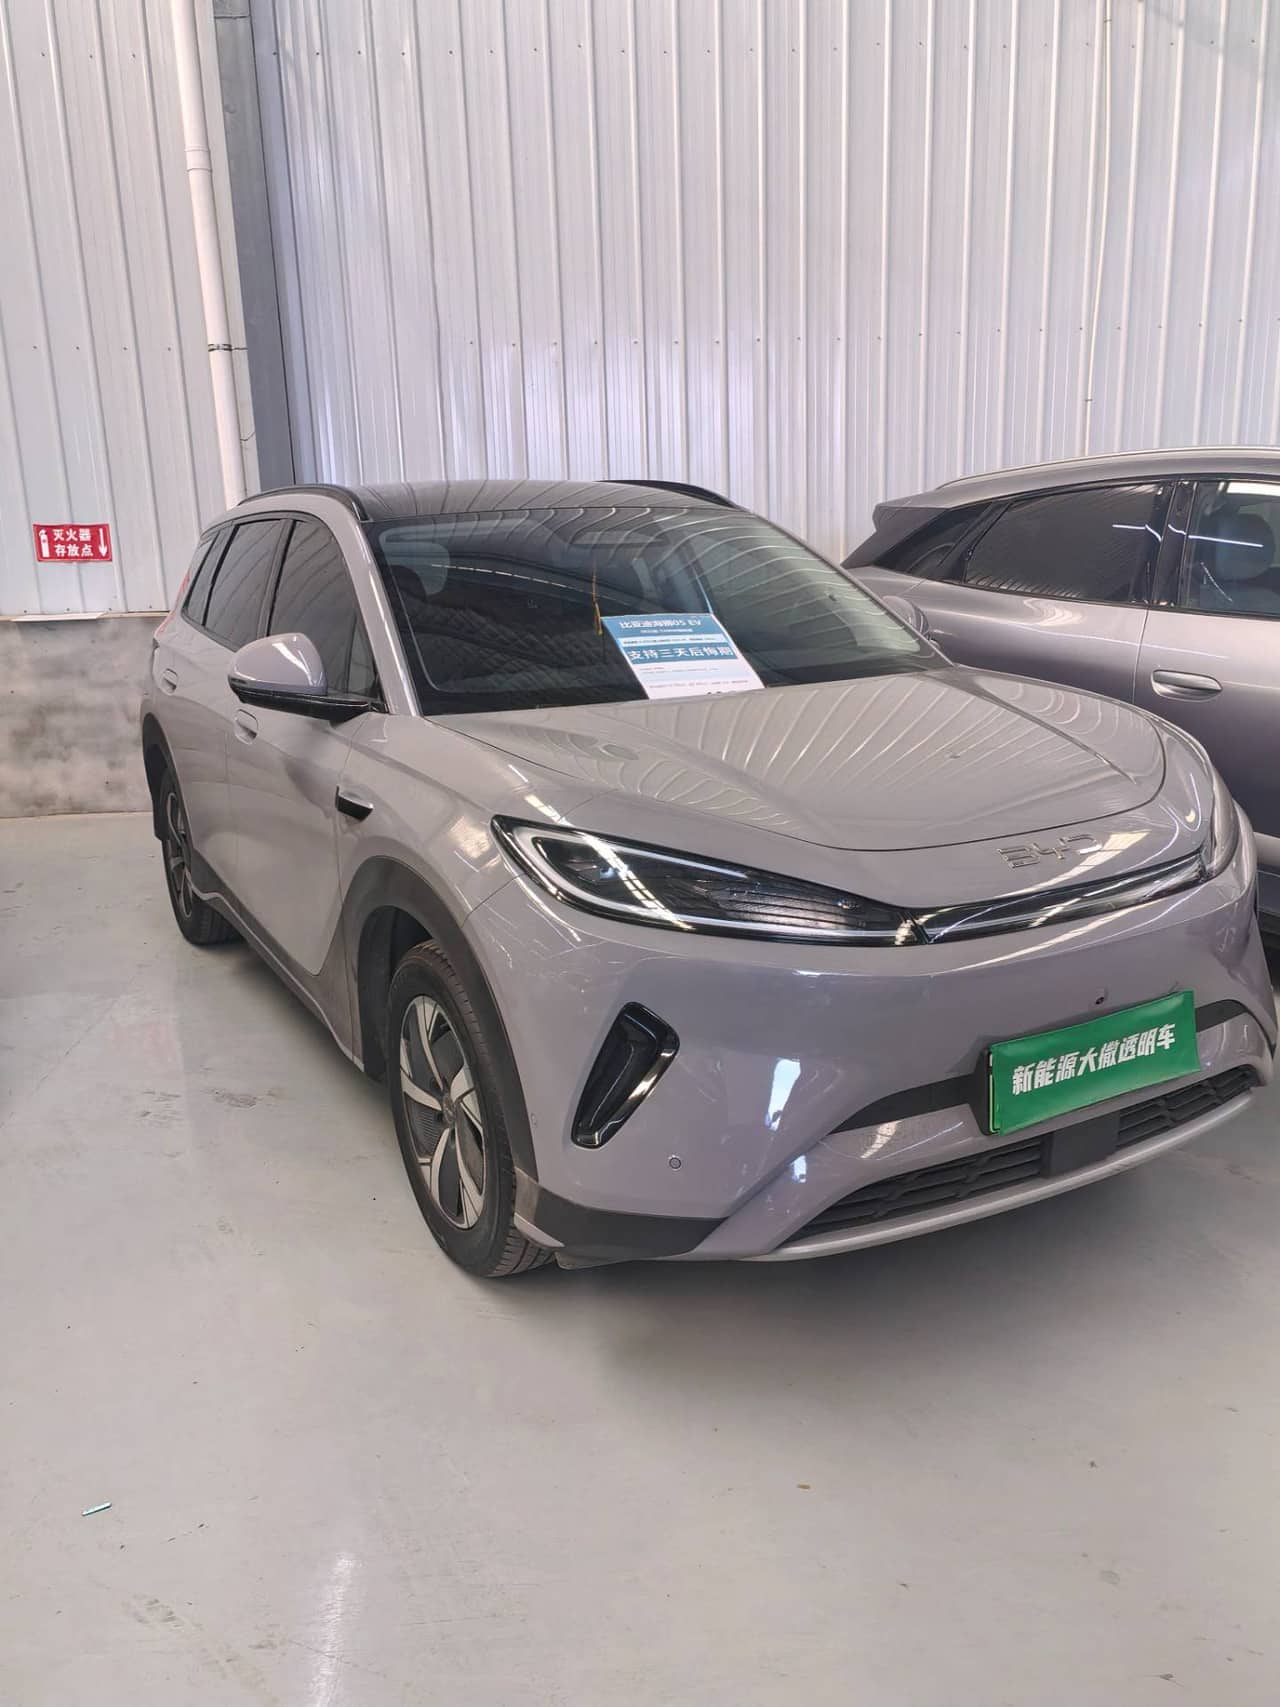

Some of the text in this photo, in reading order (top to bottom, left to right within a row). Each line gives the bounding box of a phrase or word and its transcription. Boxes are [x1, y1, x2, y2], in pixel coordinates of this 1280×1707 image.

[52, 528, 91, 541] 灭火器
[54, 543, 93, 557] 存放点
[628, 646, 734, 660] 支持三天后悔期
[996, 834, 1102, 870] BYD
